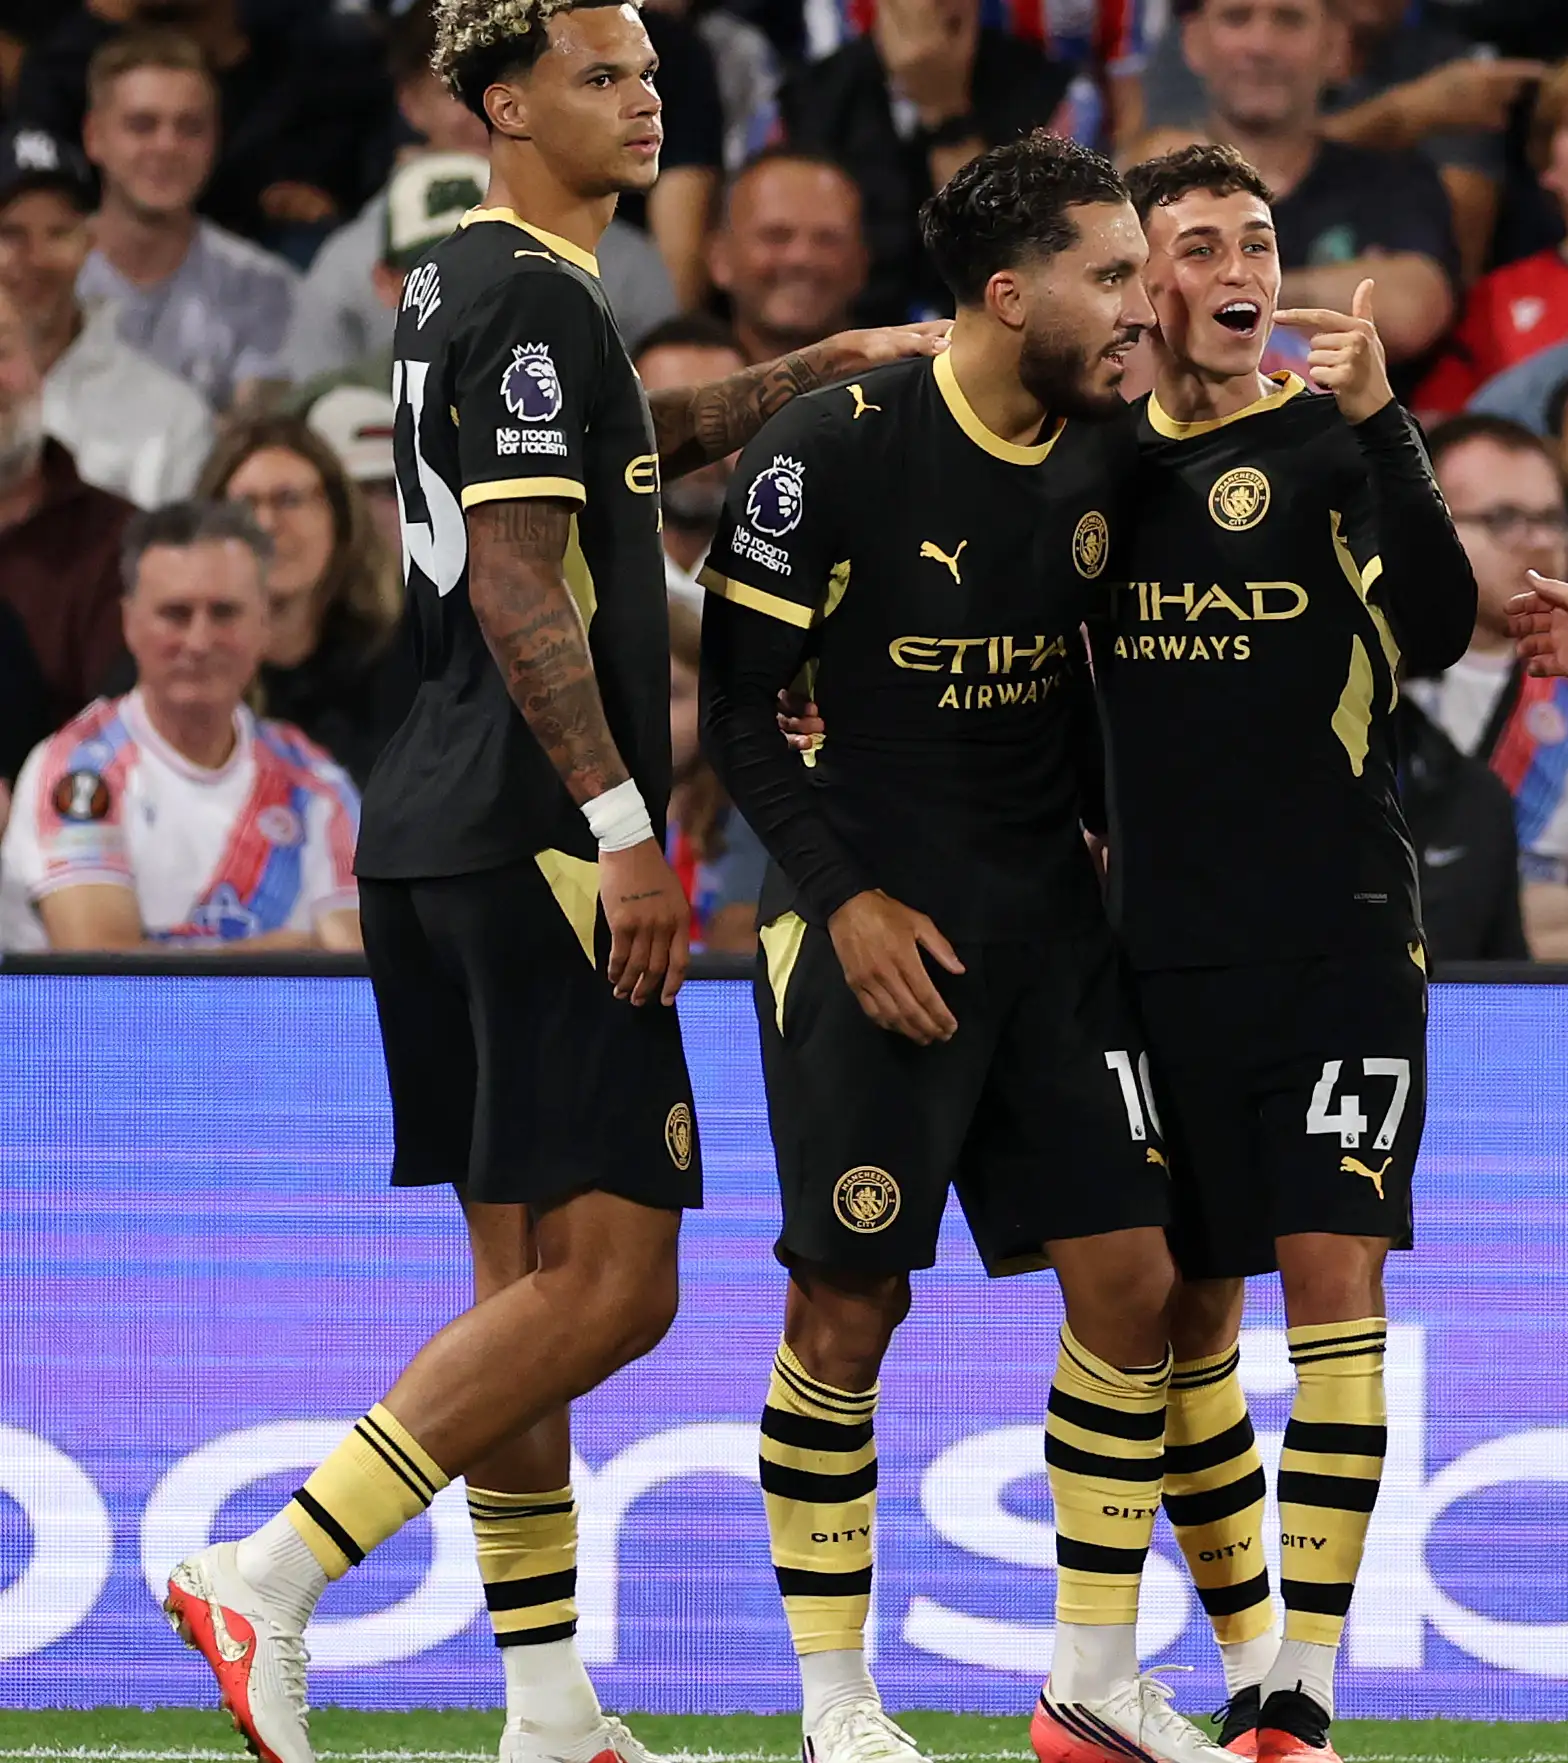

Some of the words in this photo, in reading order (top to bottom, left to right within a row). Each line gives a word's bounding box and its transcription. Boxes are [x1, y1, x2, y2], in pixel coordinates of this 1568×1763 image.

[495, 427, 520, 442] No
[521, 429, 563, 443] room
[521, 441, 568, 457] racism
[750, 536, 789, 562] room
[745, 546, 792, 576] racism
[888, 634, 1067, 675] ETIHA
[938, 675, 1060, 710] AIRWAY
[1305, 1057, 1410, 1149] 47
[856, 1220, 877, 1228] CITY
[1102, 1504, 1160, 1520] CITY
[811, 1524, 870, 1543] CITY
[1281, 1532, 1328, 1550] CITY
[1199, 1536, 1253, 1562] CITY
